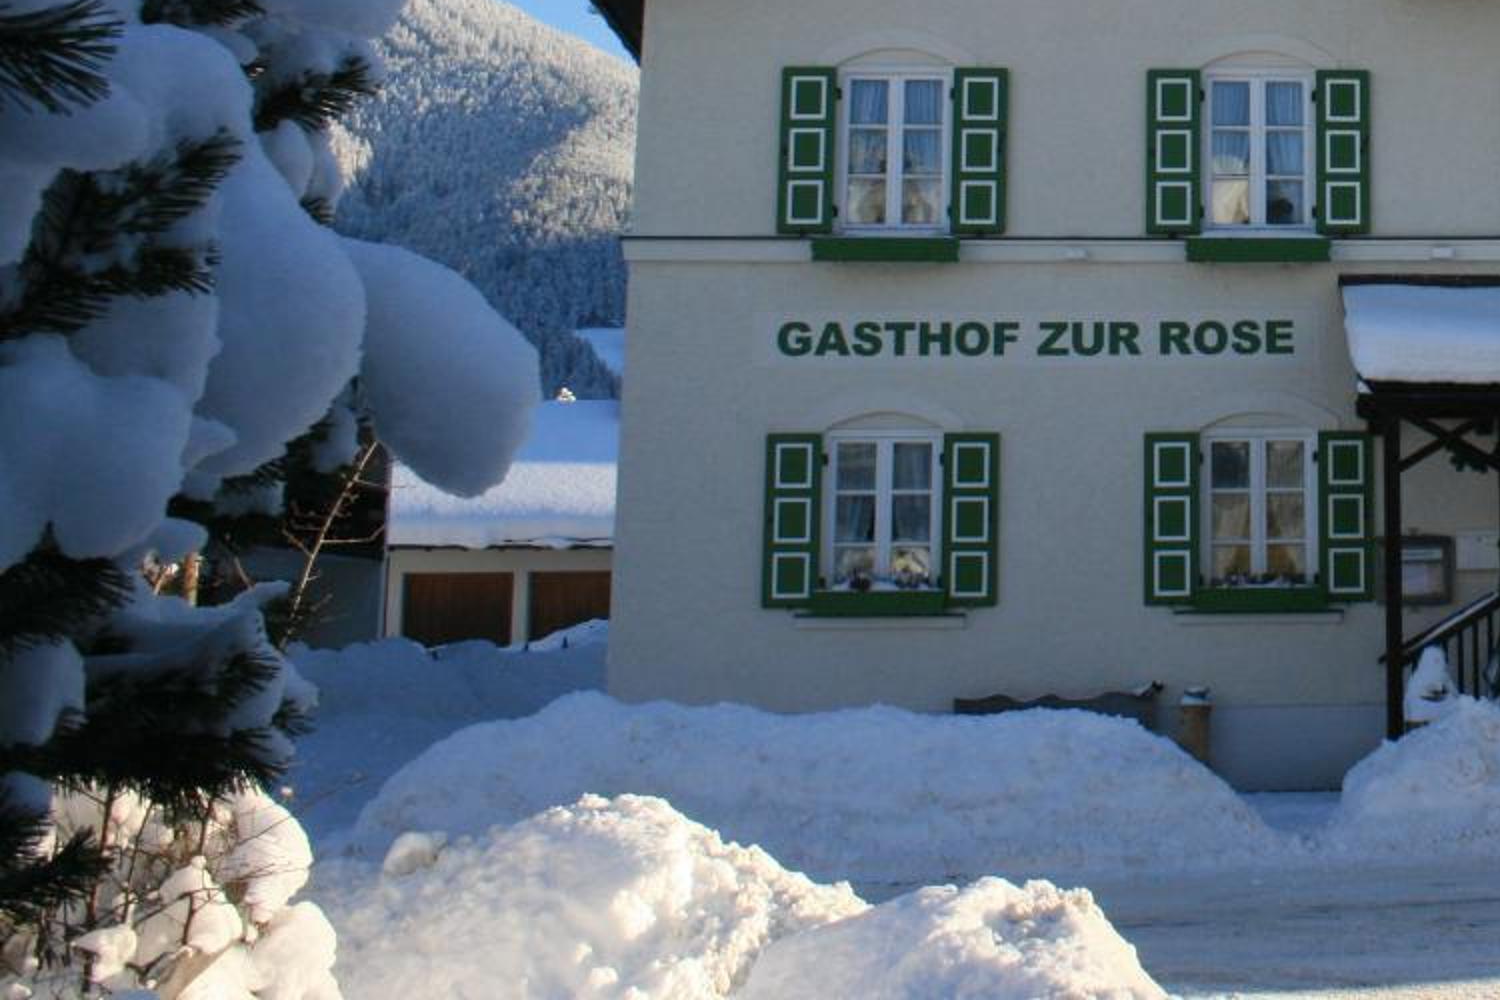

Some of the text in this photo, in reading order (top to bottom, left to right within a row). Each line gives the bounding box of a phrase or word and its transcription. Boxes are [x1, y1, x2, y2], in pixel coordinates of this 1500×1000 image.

[777, 320, 1295, 356] GASTHOF ZUR ROSE
